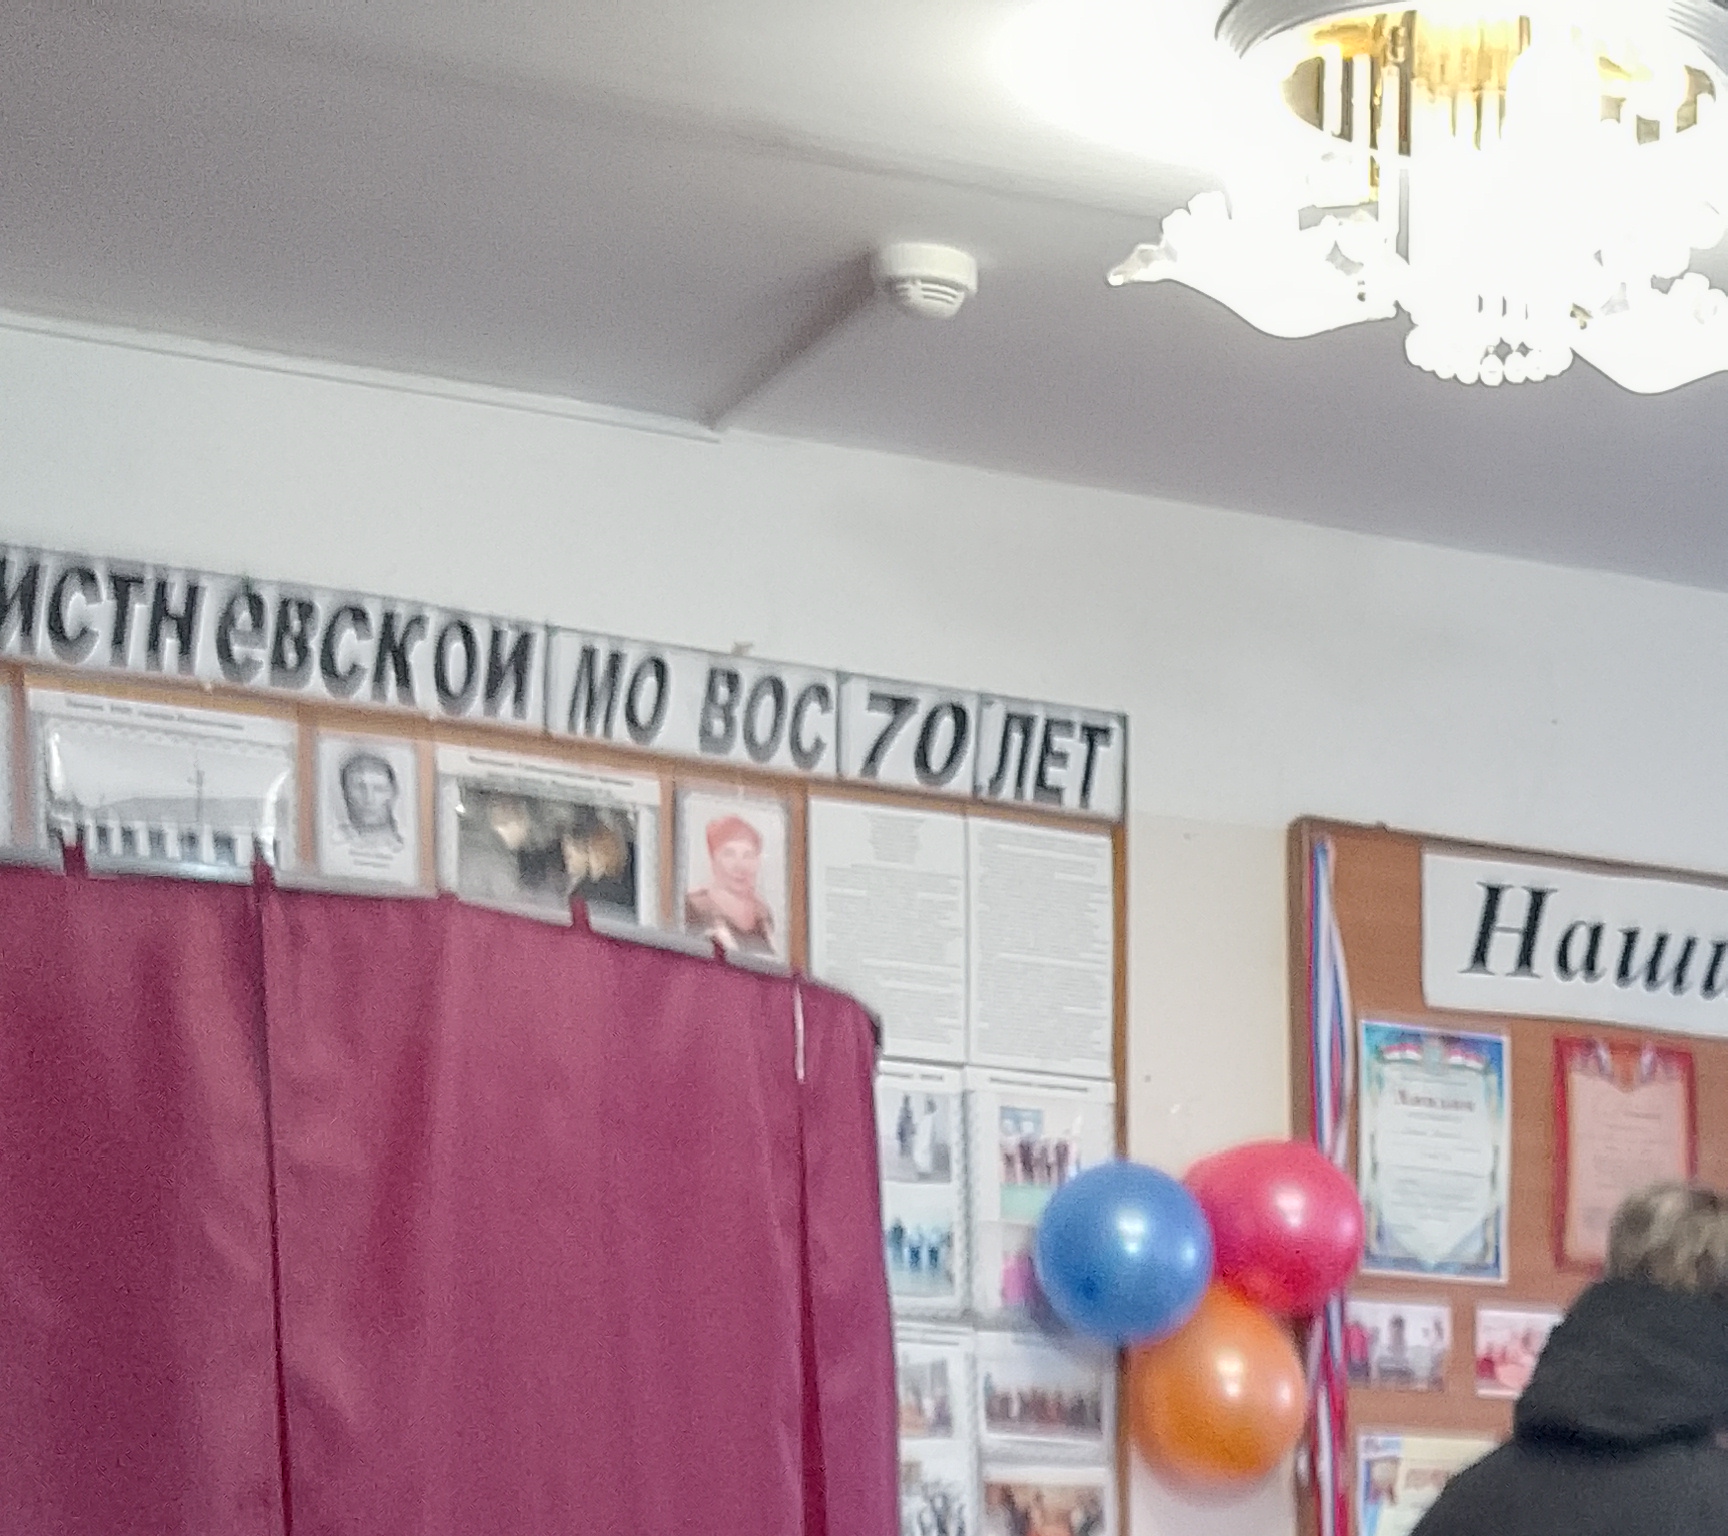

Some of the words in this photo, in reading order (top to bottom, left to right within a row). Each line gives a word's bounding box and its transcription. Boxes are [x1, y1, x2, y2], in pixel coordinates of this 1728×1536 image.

[567, 644, 667, 744] МО
[700, 666, 832, 770] ВОС
[860, 690, 967, 788] 70
[985, 710, 1112, 810] ЛЕТ
